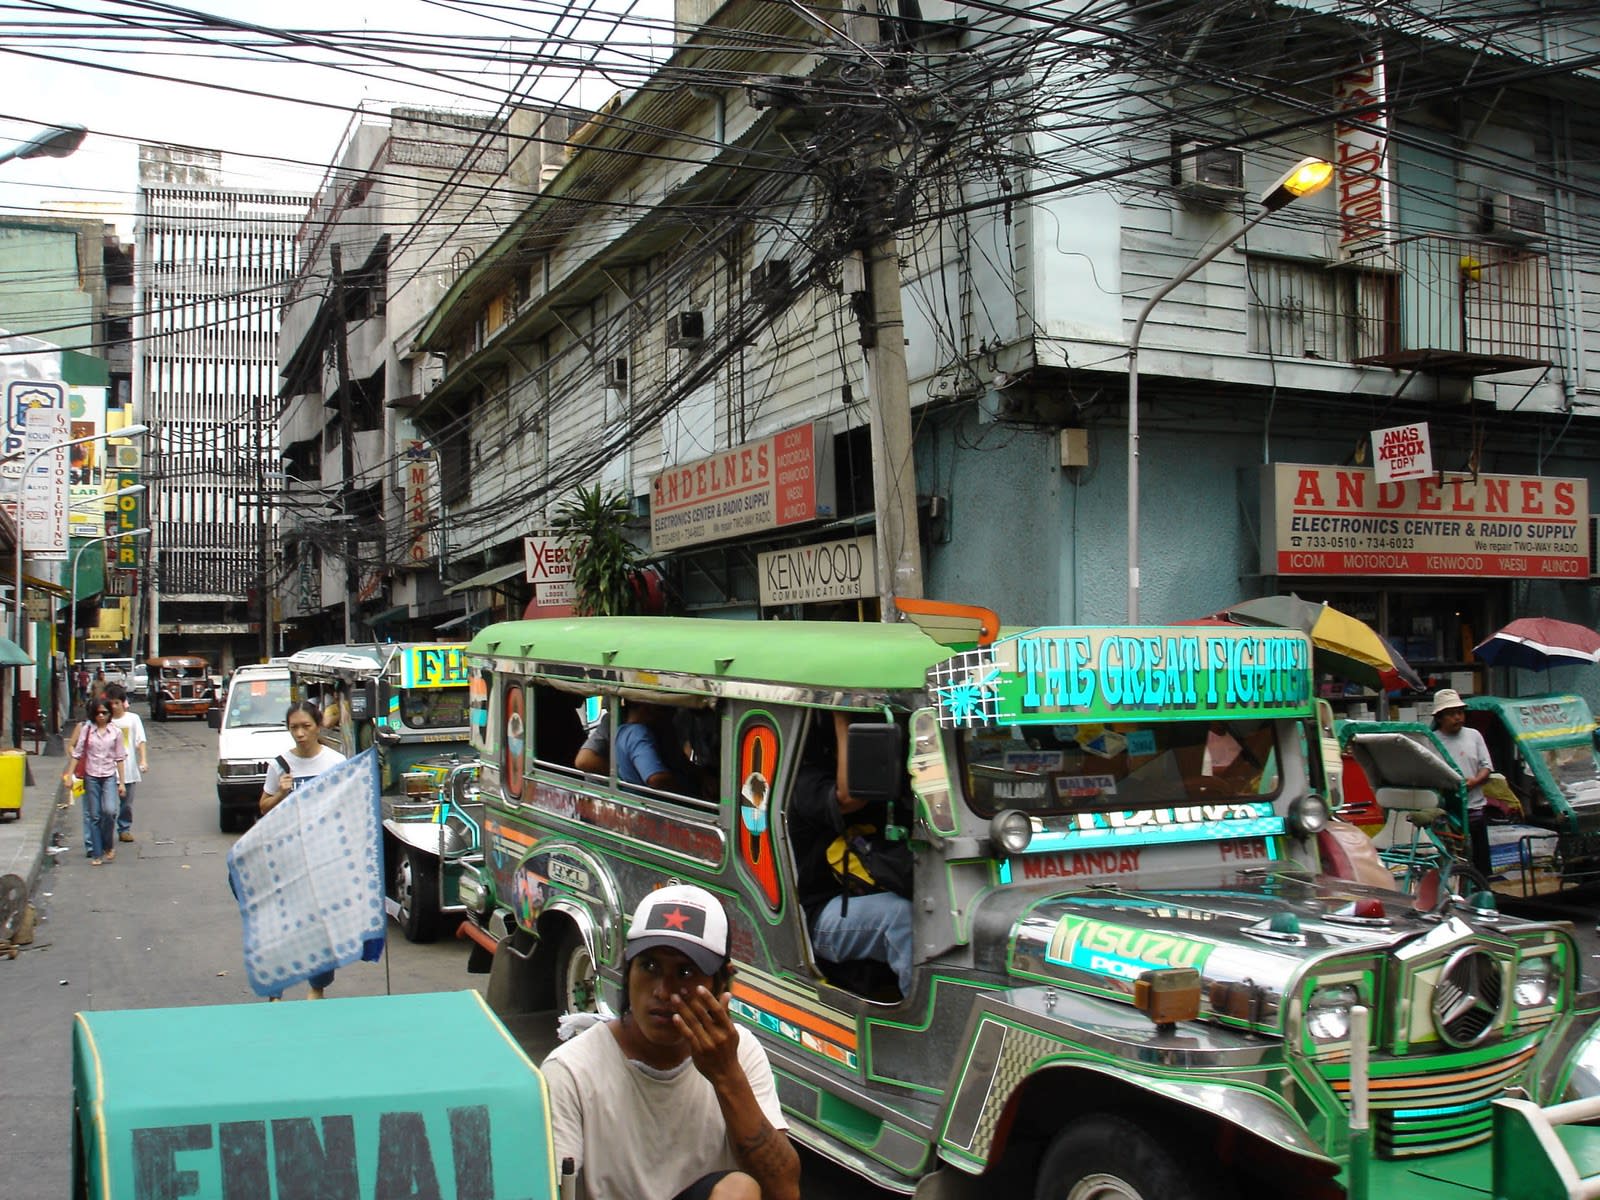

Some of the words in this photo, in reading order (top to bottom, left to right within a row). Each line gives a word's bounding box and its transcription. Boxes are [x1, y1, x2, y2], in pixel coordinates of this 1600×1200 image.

[1378, 441, 1424, 460] XEROX
[1383, 427, 1418, 445] ANA'S
[655, 444, 769, 506] ANDELNES
[1391, 456, 1415, 470] COPY
[1294, 470, 1575, 516] ANDELNES
[54, 488, 63, 547] LIGHTING
[655, 510, 691, 531] ELECTRONICS
[693, 505, 715, 522] CENTER
[717, 503, 722, 517] &
[723, 499, 742, 514] RADIO
[745, 490, 770, 510] SUPPLY
[1292, 517, 1398, 534] ELECTRONICS
[1405, 521, 1459, 536] CENTER
[1466, 523, 1475, 537] &
[1480, 523, 1522, 538] RADIO
[1527, 525, 1576, 540] SUPPLY
[1307, 536, 1356, 548] 733-0510
[1367, 537, 1414, 549] 734-6023
[1475, 540, 1487, 550] We
[1489, 541, 1512, 553] repair
[1514, 541, 1552, 552] TWO-WAY
[1554, 543, 1578, 553] RADIO
[766, 543, 862, 590] KENWOOD
[1290, 554, 1325, 568] ICOM
[1344, 555, 1409, 569] MOTOROLA
[1427, 556, 1483, 570] KENWOOD
[1499, 558, 1527, 571] YAESU
[1541, 559, 1578, 573] ALINCO
[772, 583, 859, 601] COMMUNICATIONS
[1018, 637, 1096, 708] THE
[1100, 636, 1200, 706] GREAT
[1023, 849, 1141, 879] MALANDAY
[1218, 840, 1266, 862] PIER
[1081, 921, 1199, 967] ISUZU
[131, 1104, 522, 1200] FINAL
